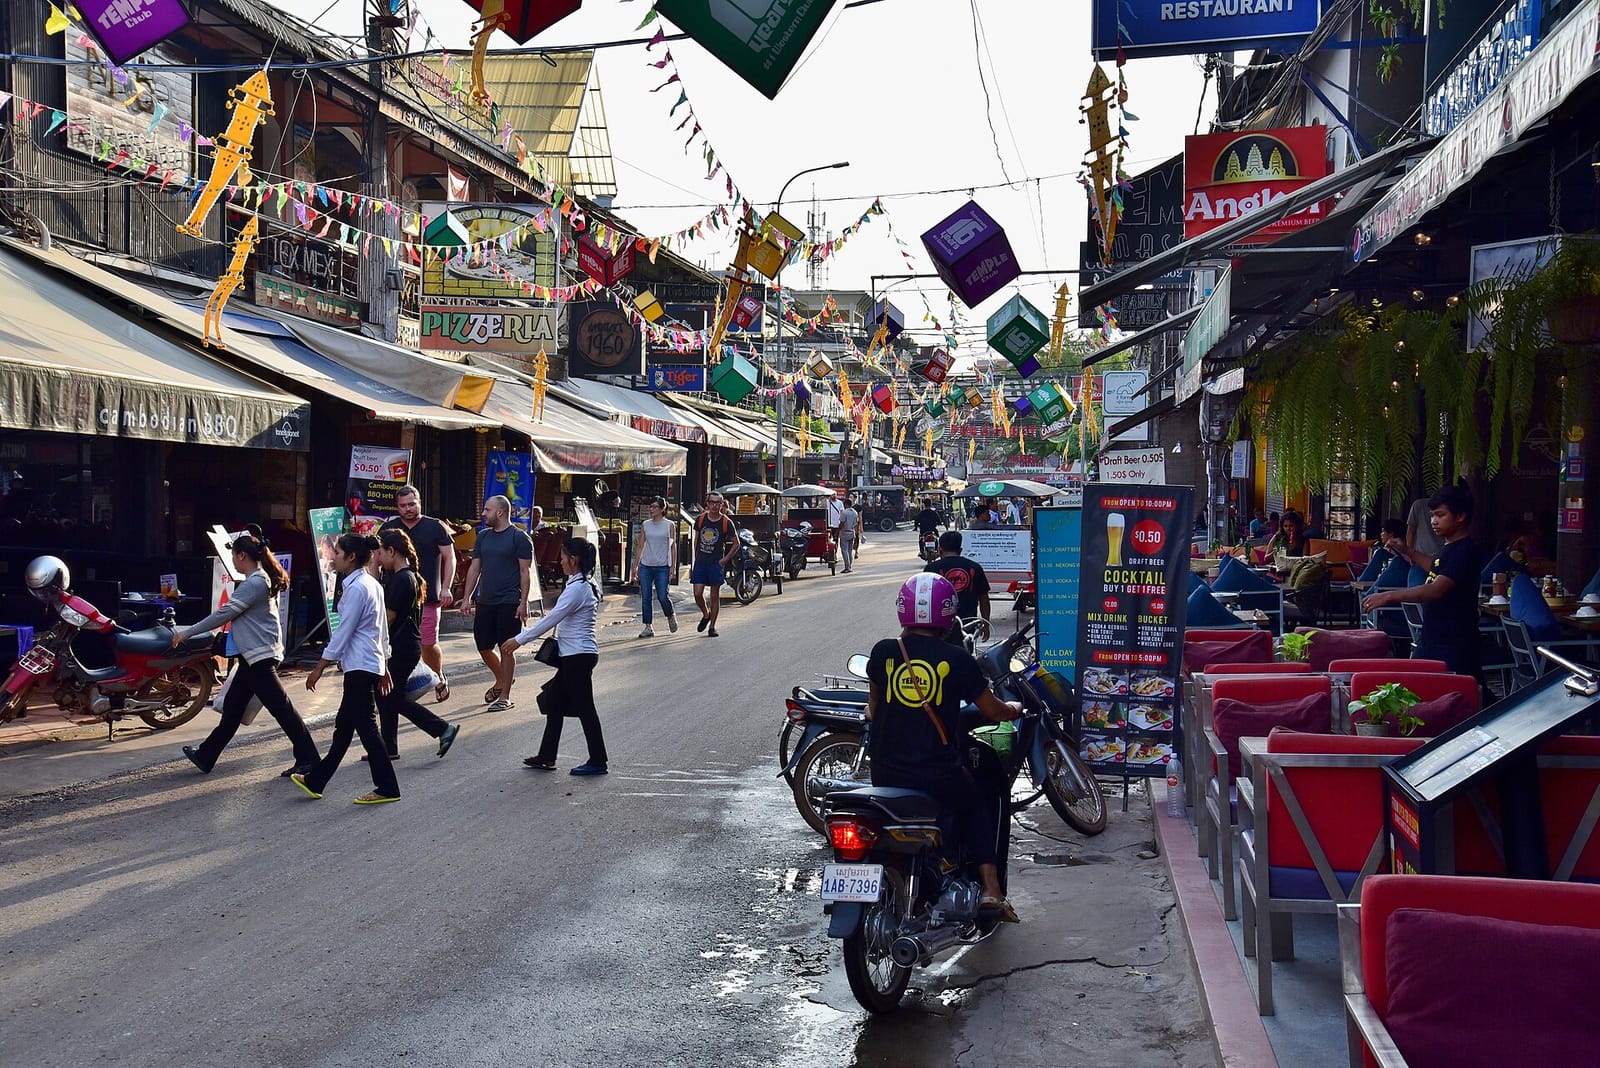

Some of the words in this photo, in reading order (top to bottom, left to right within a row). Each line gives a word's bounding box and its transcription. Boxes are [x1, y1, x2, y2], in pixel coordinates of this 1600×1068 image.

[1161, 0, 1294, 20] RESTAURANT
[125, 10, 152, 28] Club
[965, 253, 1008, 286] TEMPLE
[262, 278, 310, 312] TEX
[316, 293, 363, 325] MEX
[422, 311, 553, 344] PIZZERIA
[666, 370, 698, 386] Tiger
[99, 403, 197, 433] cambodian
[204, 412, 237, 439] BBQ
[1104, 455, 1122, 466] Draft
[1124, 455, 1141, 465] Beer
[1129, 470, 1146, 479] Only
[367, 490, 380, 498] BBQ
[1120, 499, 1136, 507] OPEN
[1145, 500, 1172, 508] 10:00PM
[1135, 530, 1161, 543] $0.50
[1149, 558, 1164, 566] BEER
[1104, 569, 1166, 585] COCKTAIL
[1103, 584, 1119, 592] BUY
[1127, 585, 1140, 593] GET
[1146, 585, 1166, 595] FREE
[1087, 613, 1102, 621] MIX
[1103, 614, 1128, 623] DRINK
[1138, 615, 1168, 624] BUCKET
[902, 676, 927, 685] TEPLE
[823, 878, 878, 893] 1AB-7396
